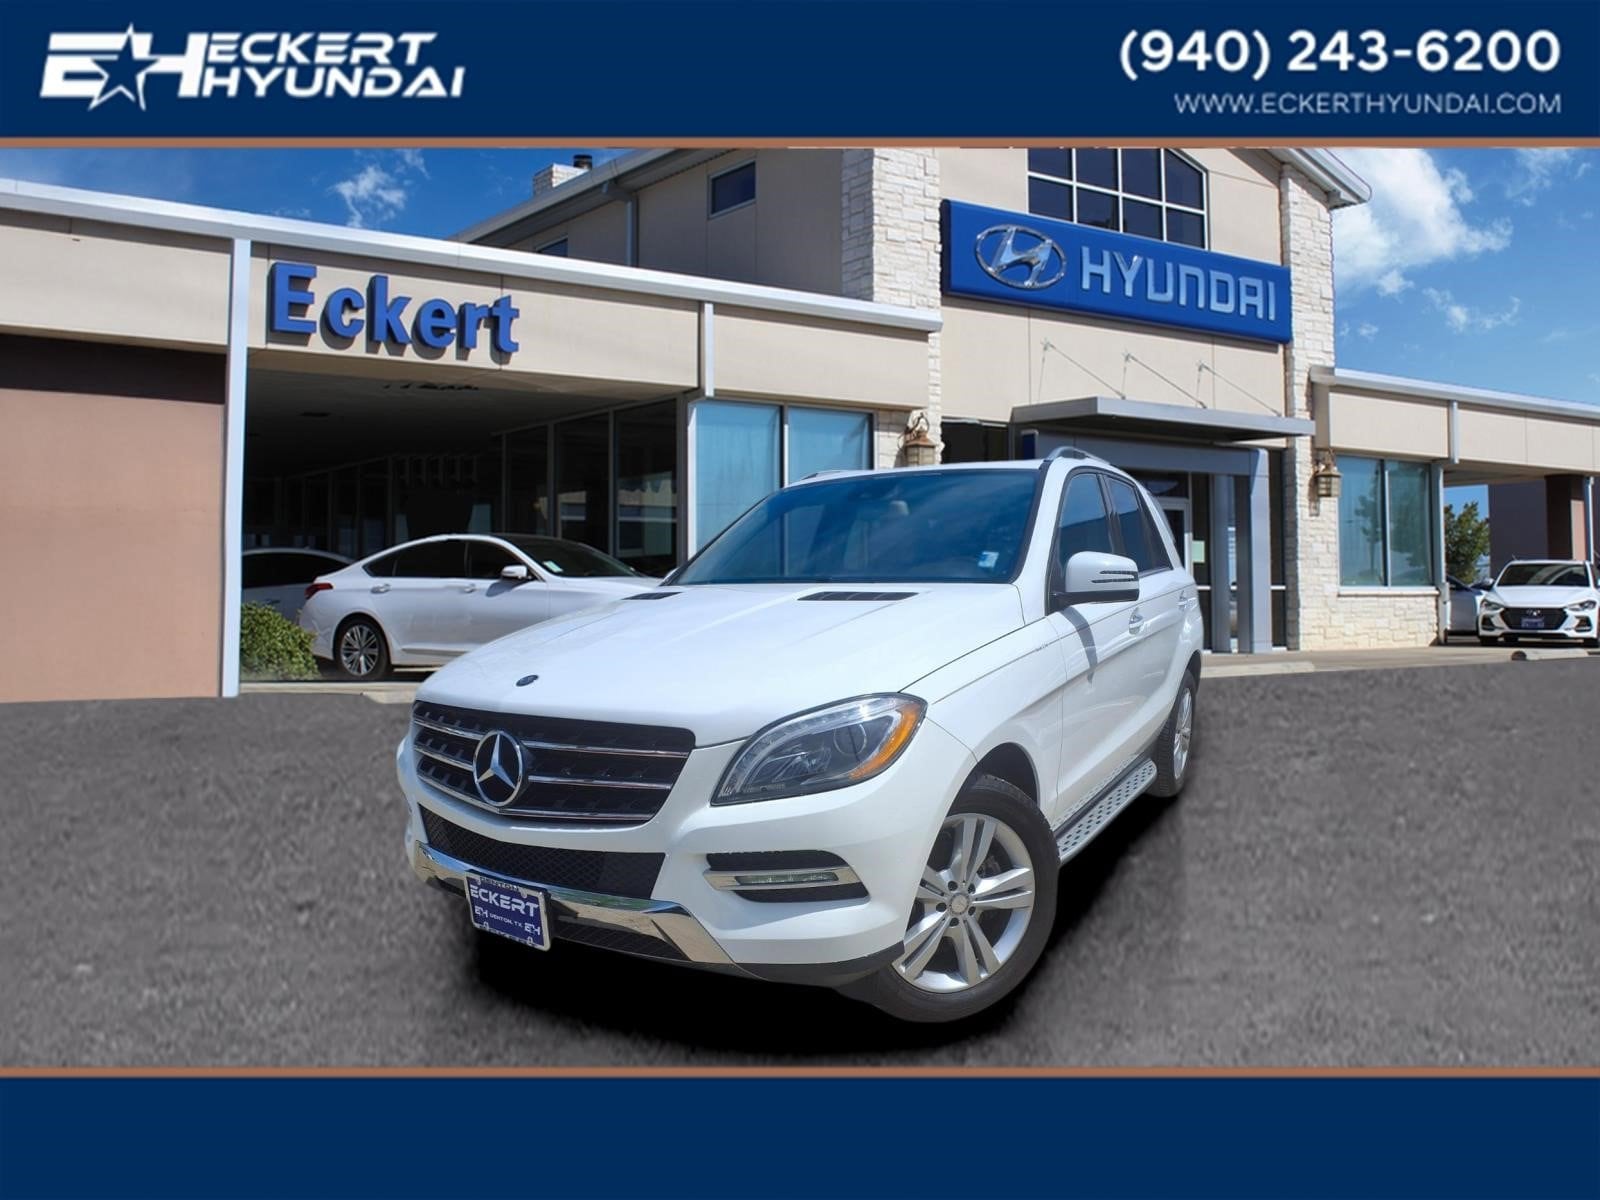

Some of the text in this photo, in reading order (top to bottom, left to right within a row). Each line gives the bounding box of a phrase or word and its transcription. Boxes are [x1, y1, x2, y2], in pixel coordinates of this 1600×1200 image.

[269, 261, 520, 354] Eckert
[1081, 246, 1277, 321] HYUNDAI
[469, 884, 539, 917] ECKERT
